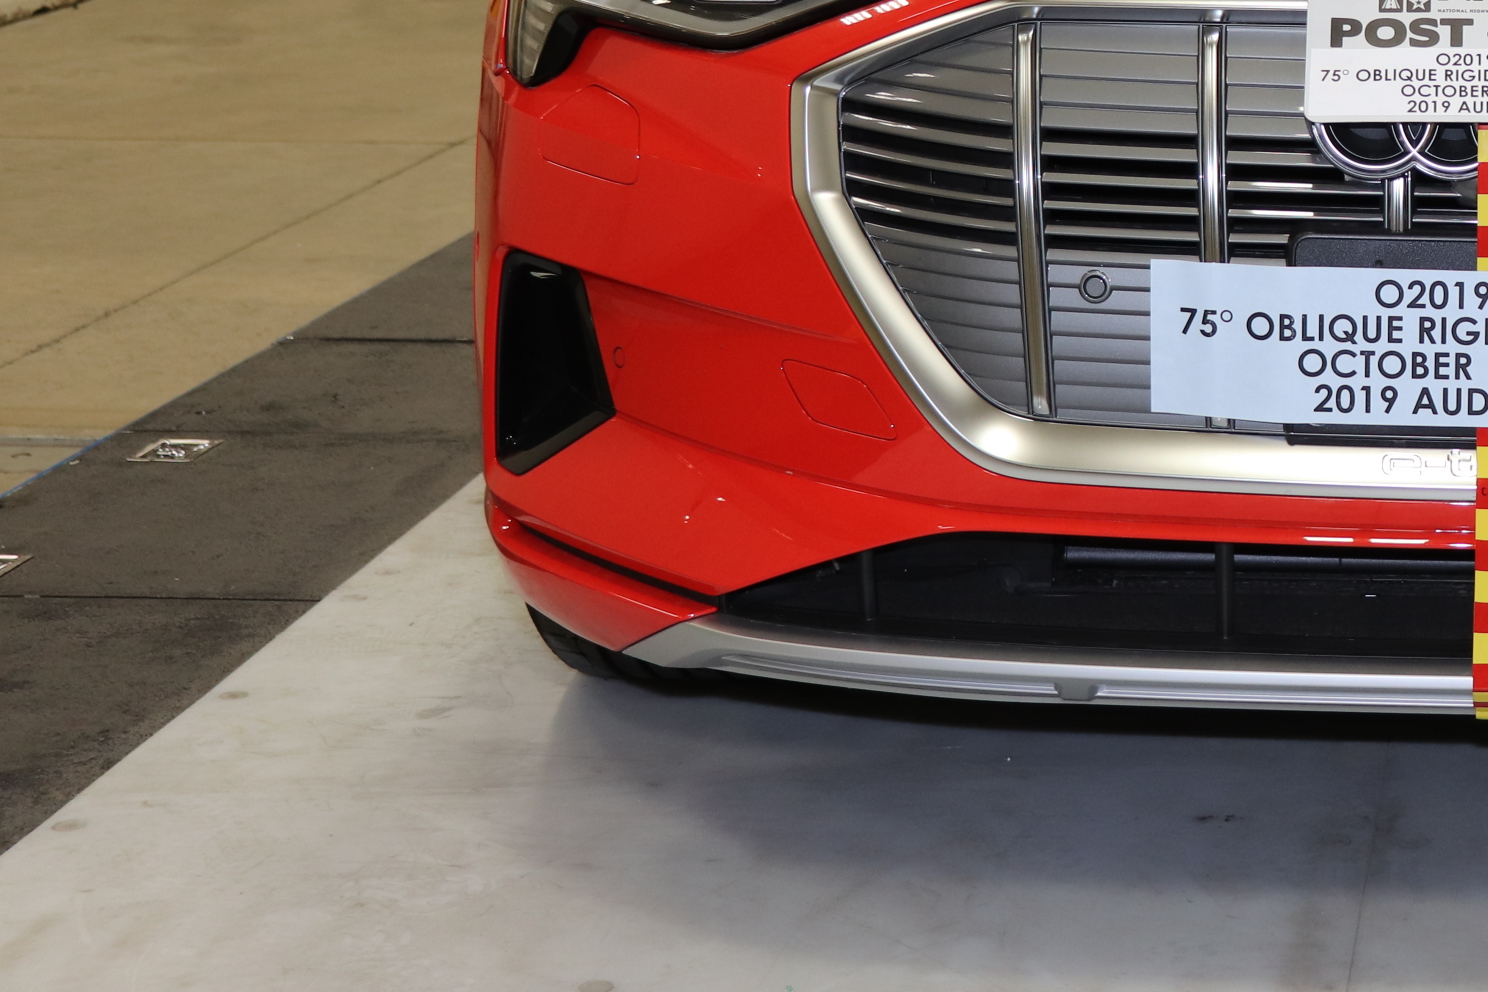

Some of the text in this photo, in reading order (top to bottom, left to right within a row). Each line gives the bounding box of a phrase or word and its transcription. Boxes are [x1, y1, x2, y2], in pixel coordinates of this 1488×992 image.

[1329, 17, 1474, 48] POST
[1321, 68, 1350, 82] 75°
[1355, 68, 1437, 82] OBLIQUE
[1407, 100, 1451, 113] 2019
[1179, 306, 1234, 338] 75°
[1245, 311, 1404, 345] OBLIQUE
[1297, 348, 1473, 381] OCTOBER
[1313, 383, 1399, 415] 2019
